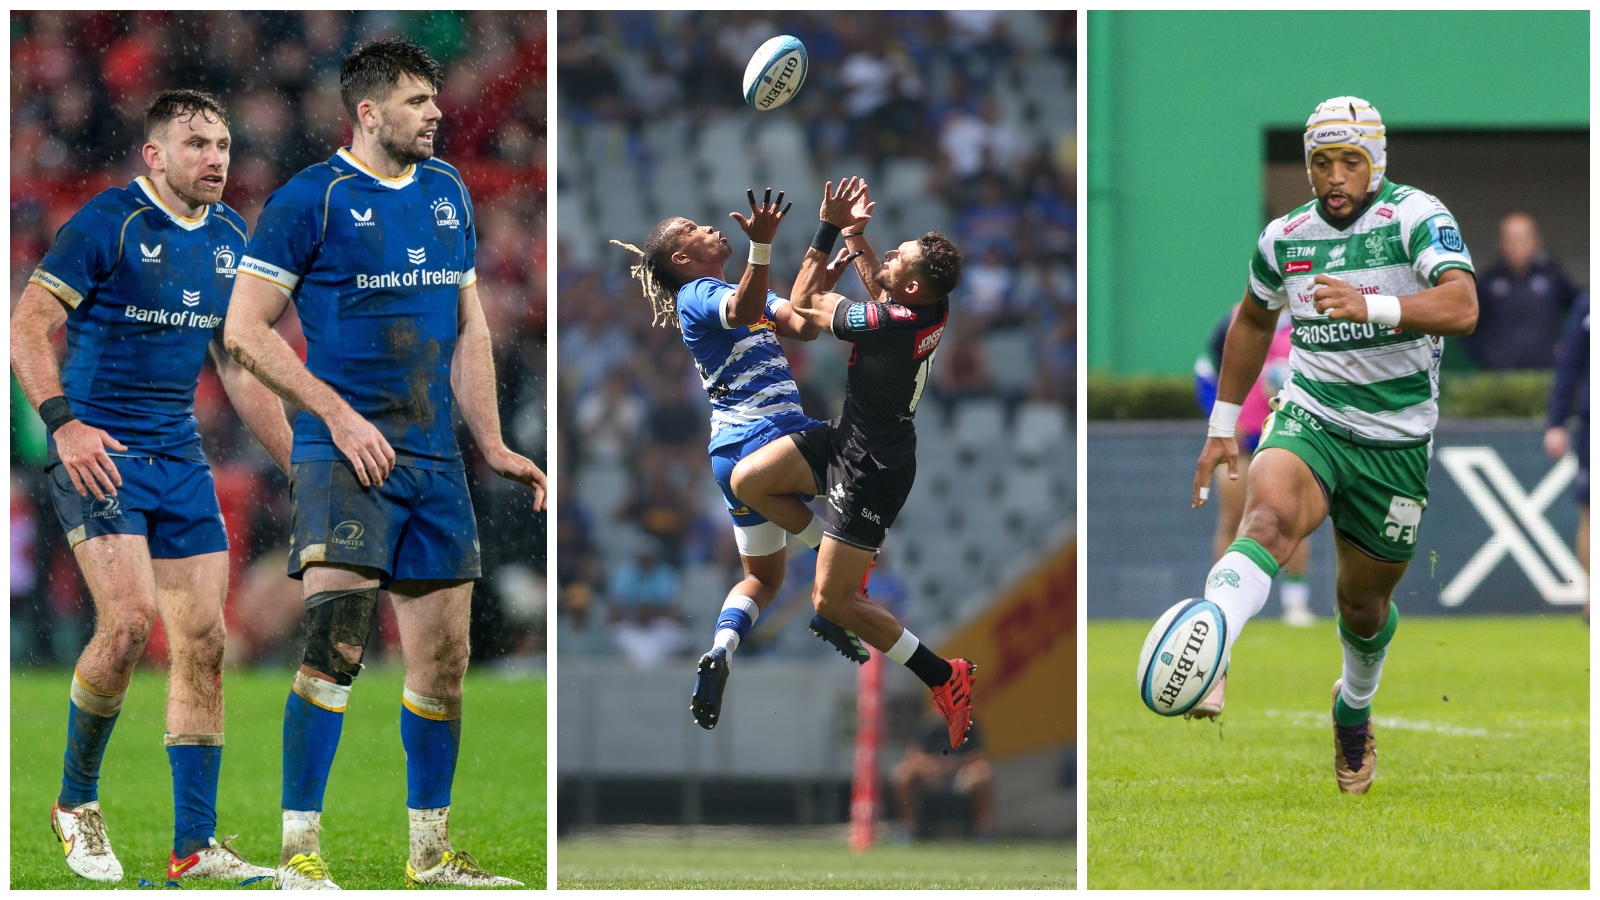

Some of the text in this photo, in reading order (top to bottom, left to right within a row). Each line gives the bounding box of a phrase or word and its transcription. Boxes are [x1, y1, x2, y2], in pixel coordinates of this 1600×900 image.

[759, 56, 799, 109] GILBERT
[1316, 130, 1348, 139] IMPACT
[1296, 246, 1317, 257] TIM
[253, 264, 279, 278] Ireland
[356, 268, 463, 289] Bank of Irelan
[38, 273, 60, 289] Ireland
[124, 304, 223, 329] Bank of Irela
[90, 509, 122, 519] LEINSTER
[331, 537, 365, 547] LEINSTER
[1158, 620, 1210, 709] GILBERT
